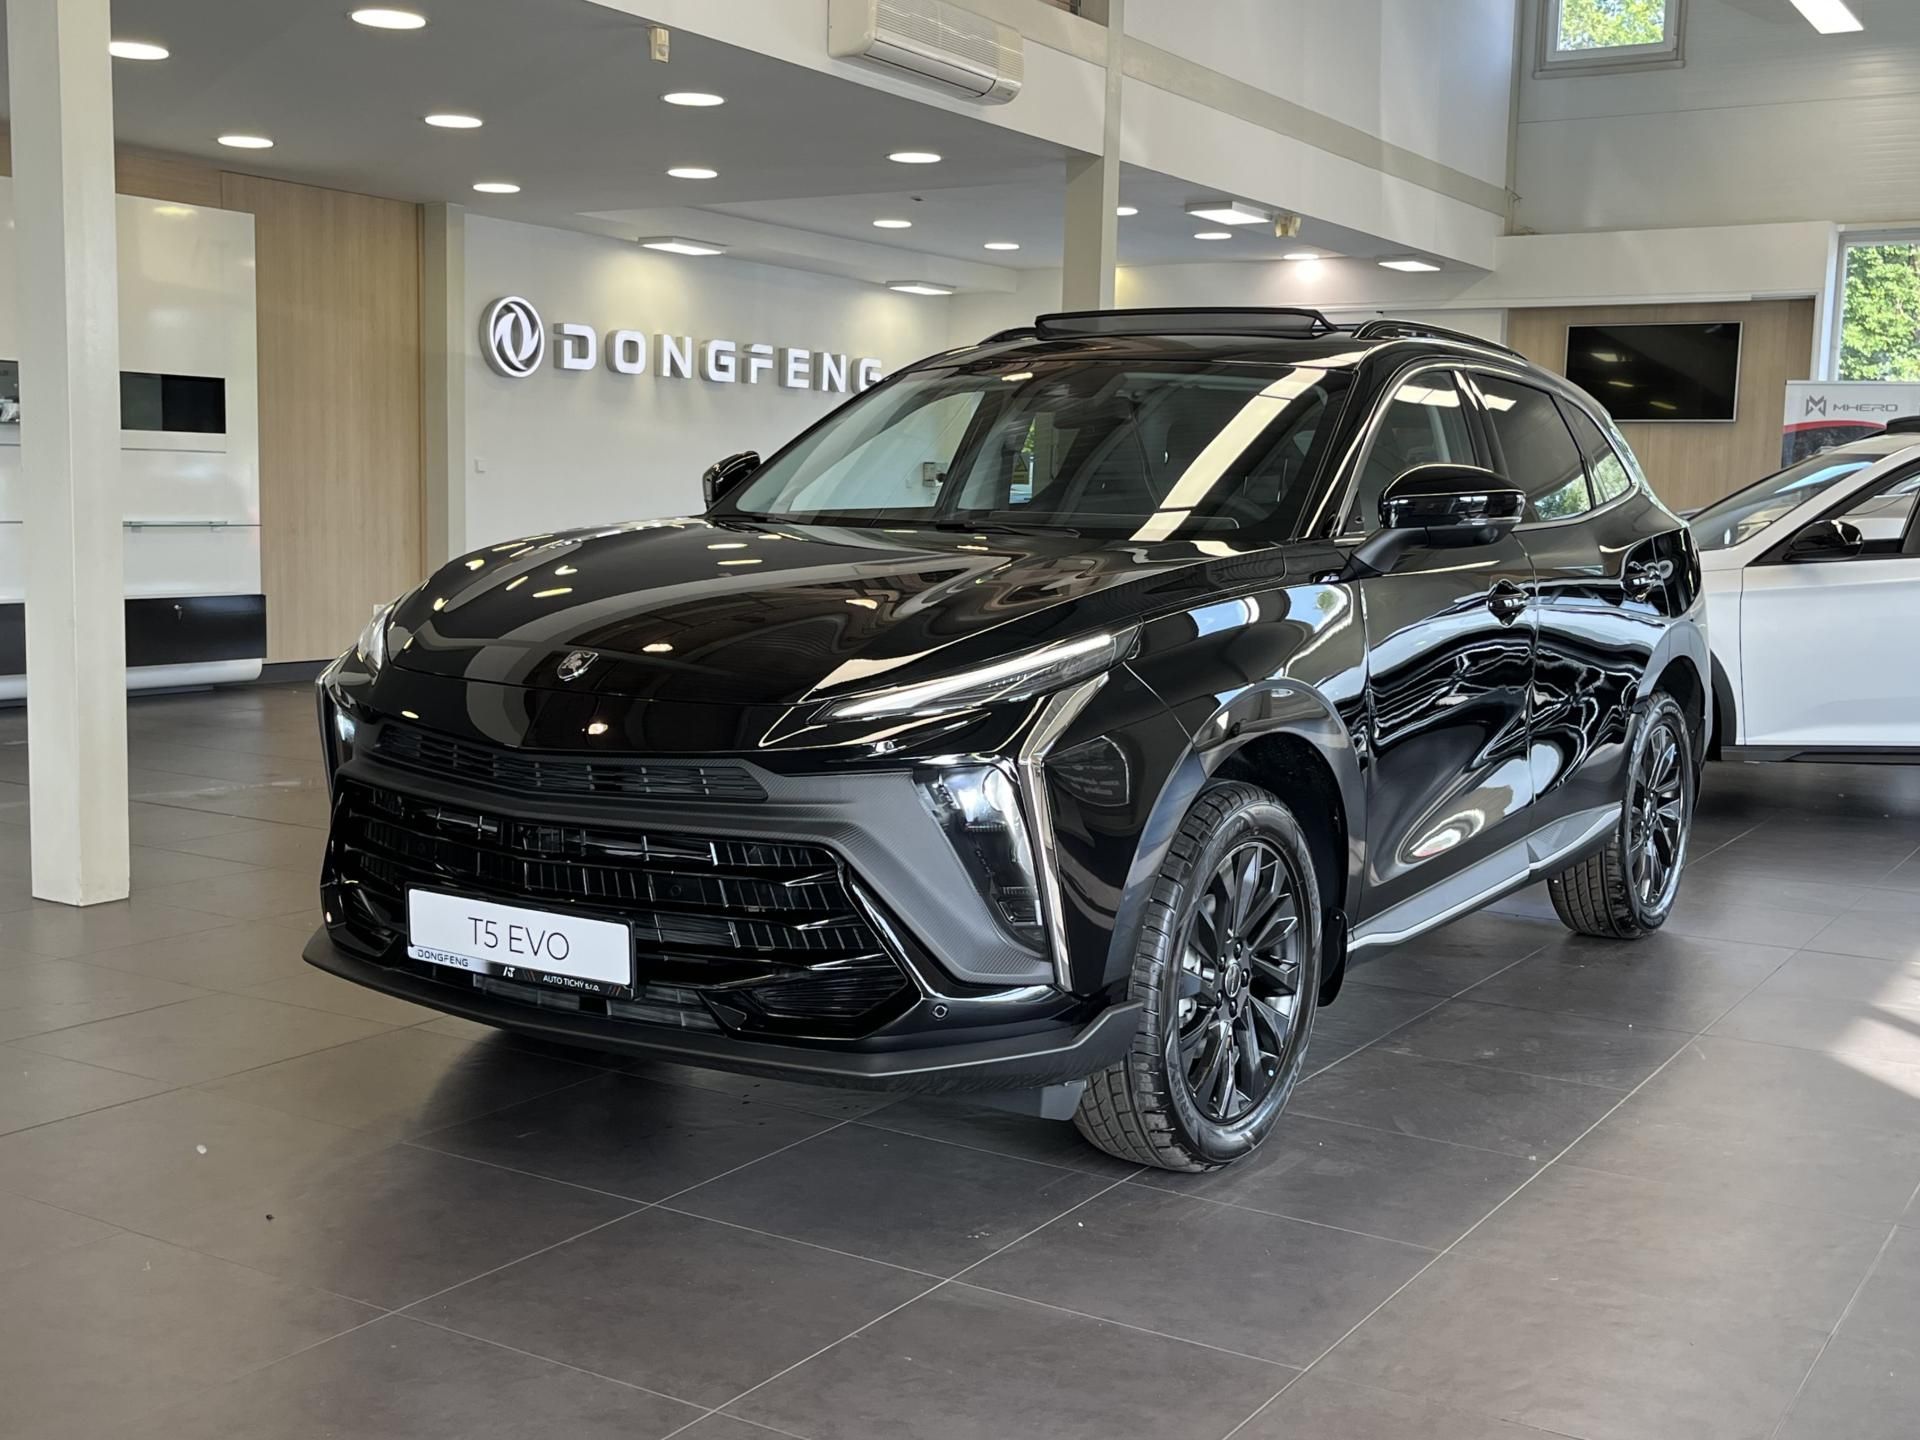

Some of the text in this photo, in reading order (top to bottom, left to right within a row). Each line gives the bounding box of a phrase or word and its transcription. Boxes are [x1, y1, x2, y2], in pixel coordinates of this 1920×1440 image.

[554, 322, 883, 393] DONGFENG
[1833, 404, 1898, 412] MHERO
[467, 917, 569, 960] T5 EVO
[418, 949, 469, 967] DONGFENG
[543, 974, 563, 985] AUTO
[585, 983, 600, 992] s.r.o.
